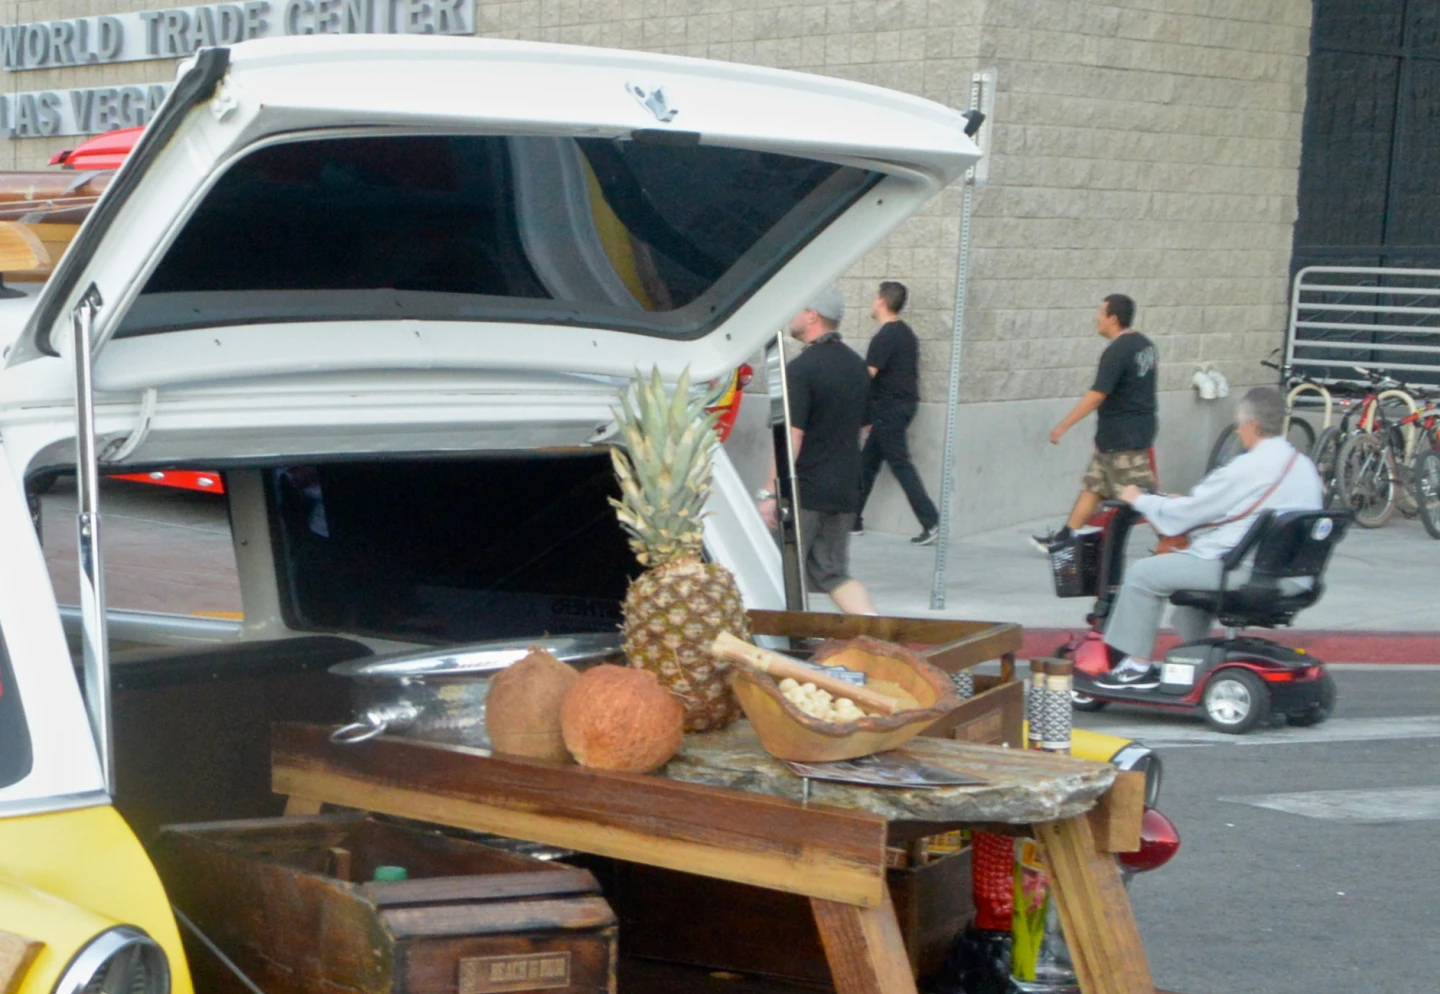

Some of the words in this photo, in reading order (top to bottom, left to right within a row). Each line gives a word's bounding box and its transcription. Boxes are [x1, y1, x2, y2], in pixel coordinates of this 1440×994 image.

[139, 0, 271, 54] TRADE
[284, 0, 470, 34] CENTER
[70, 84, 167, 132] VEGA
